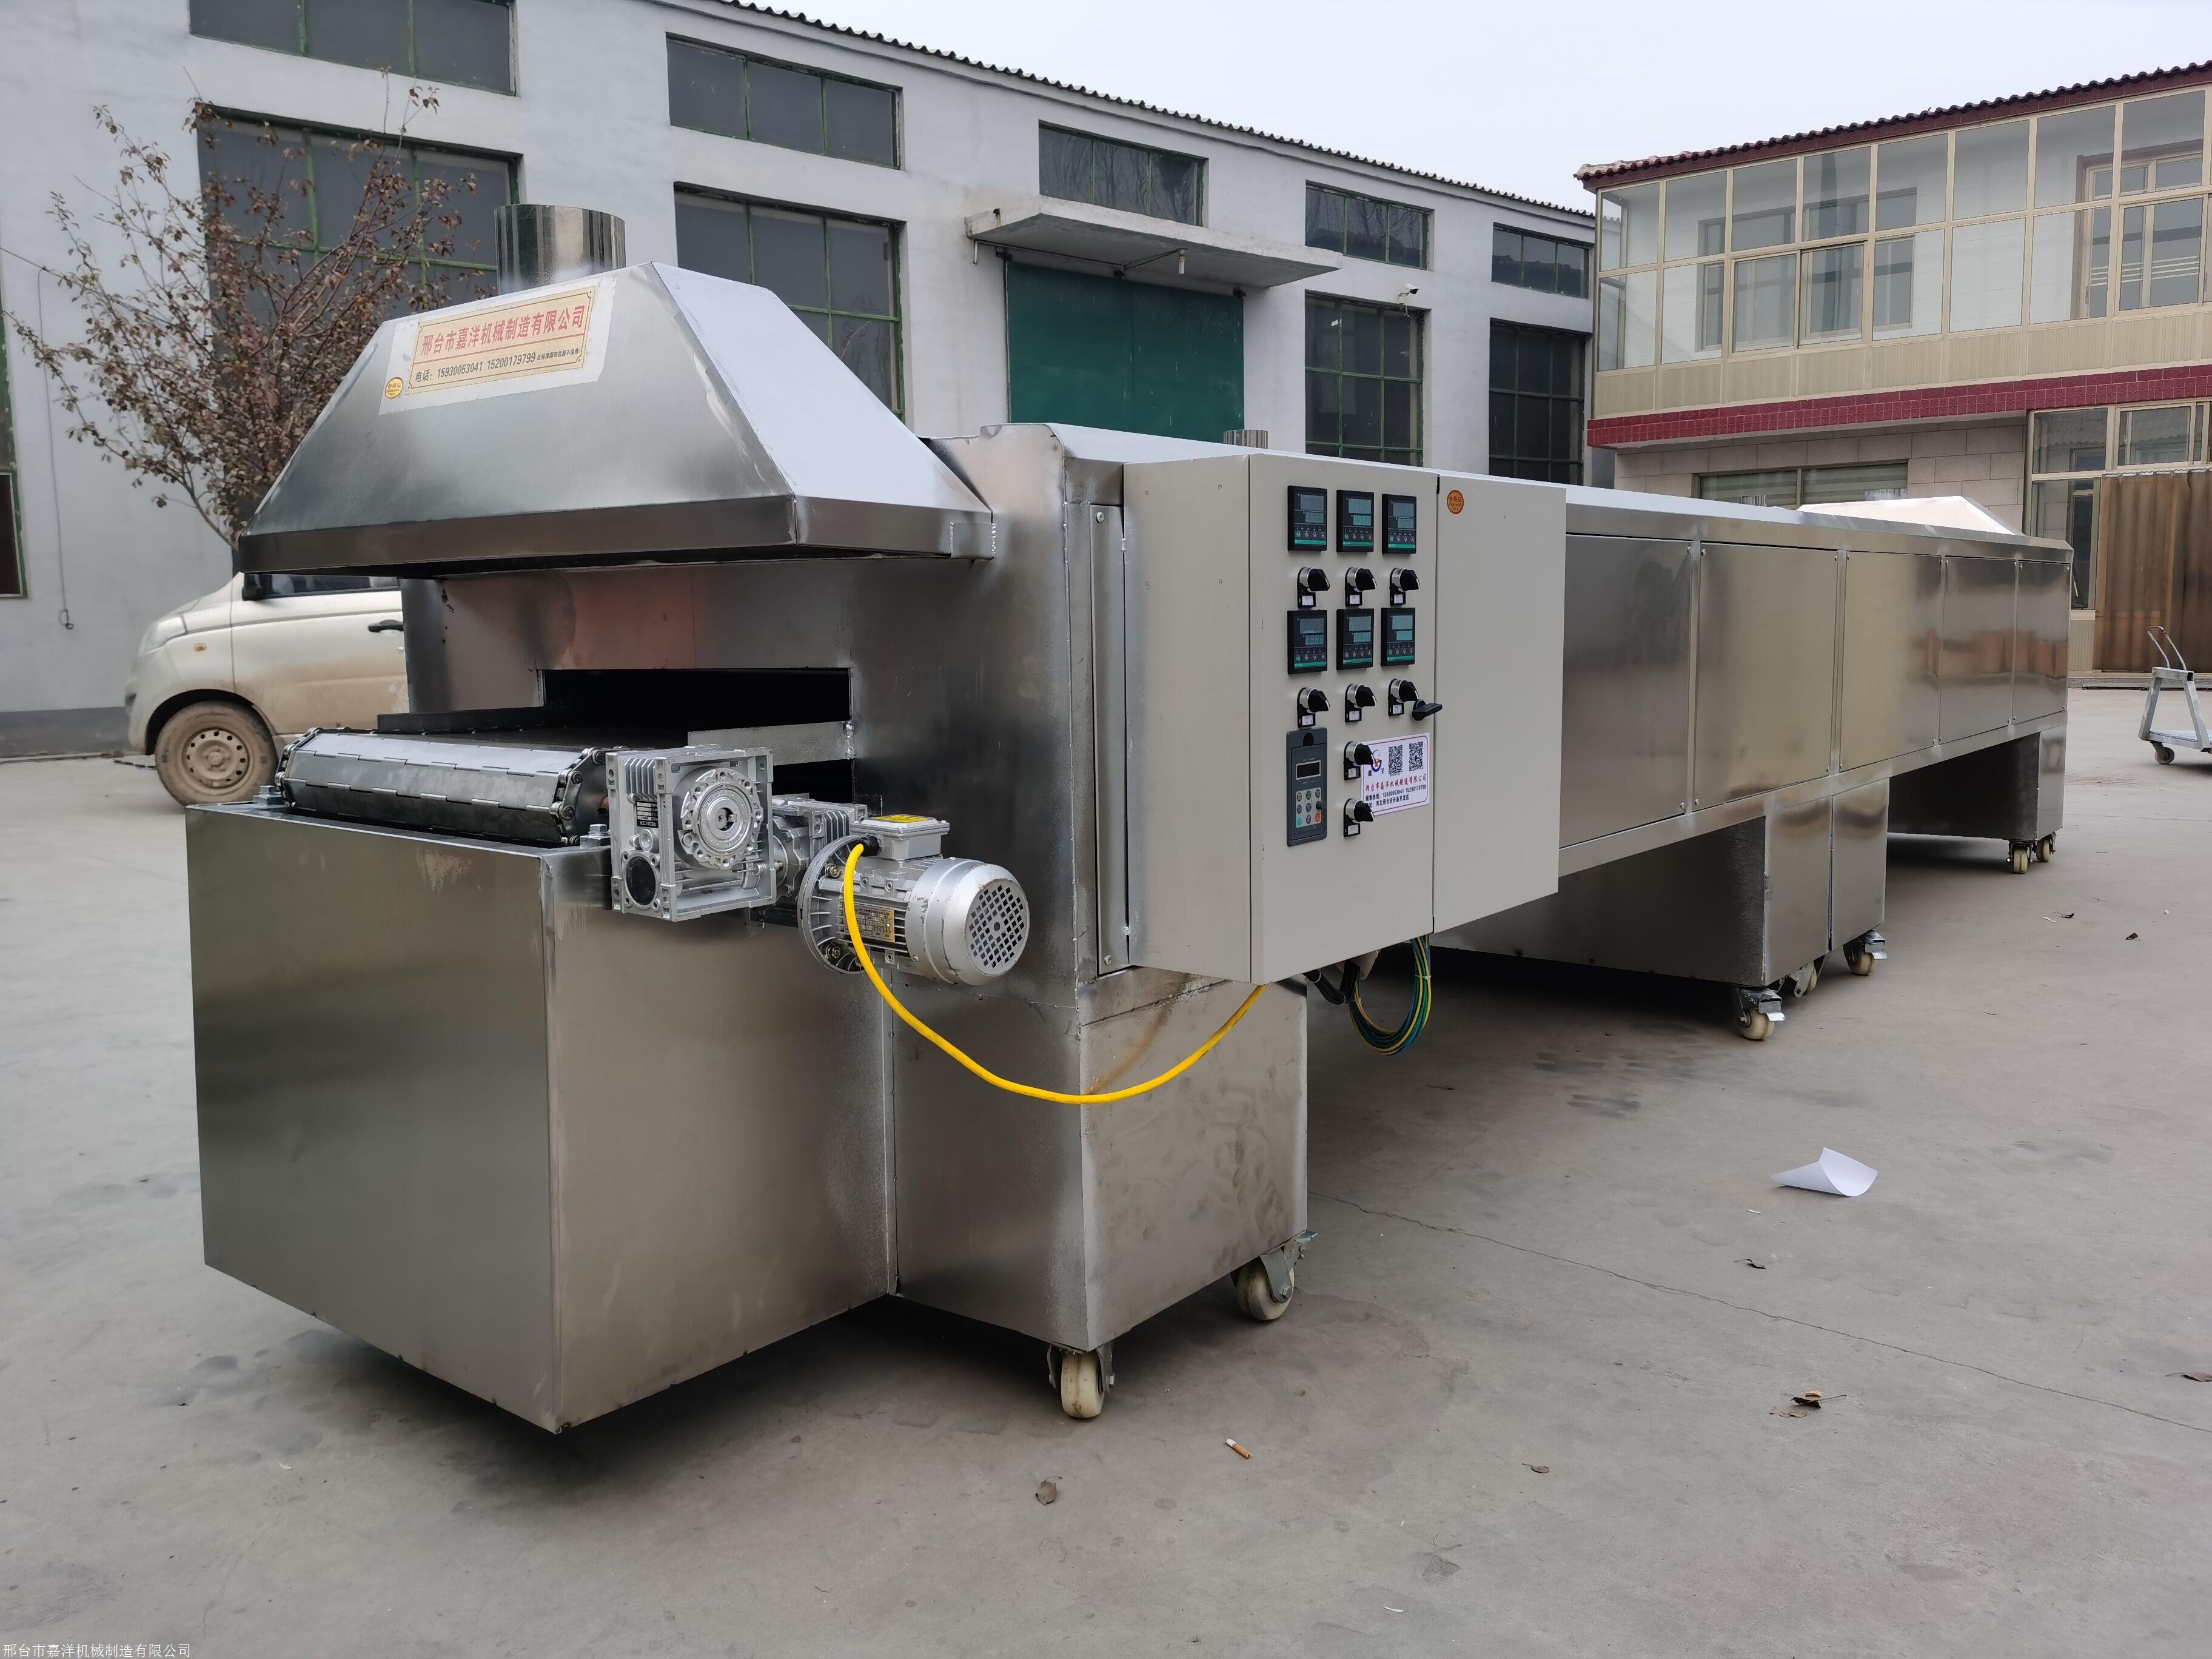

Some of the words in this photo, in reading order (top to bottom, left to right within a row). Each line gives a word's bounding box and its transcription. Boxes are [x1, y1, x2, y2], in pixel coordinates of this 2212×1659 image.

[420, 305, 585, 356] 邢台市嘉洋机械制造有限公司
[437, 361, 483, 378] 15930053041
[488, 352, 536, 370] 15200179799
